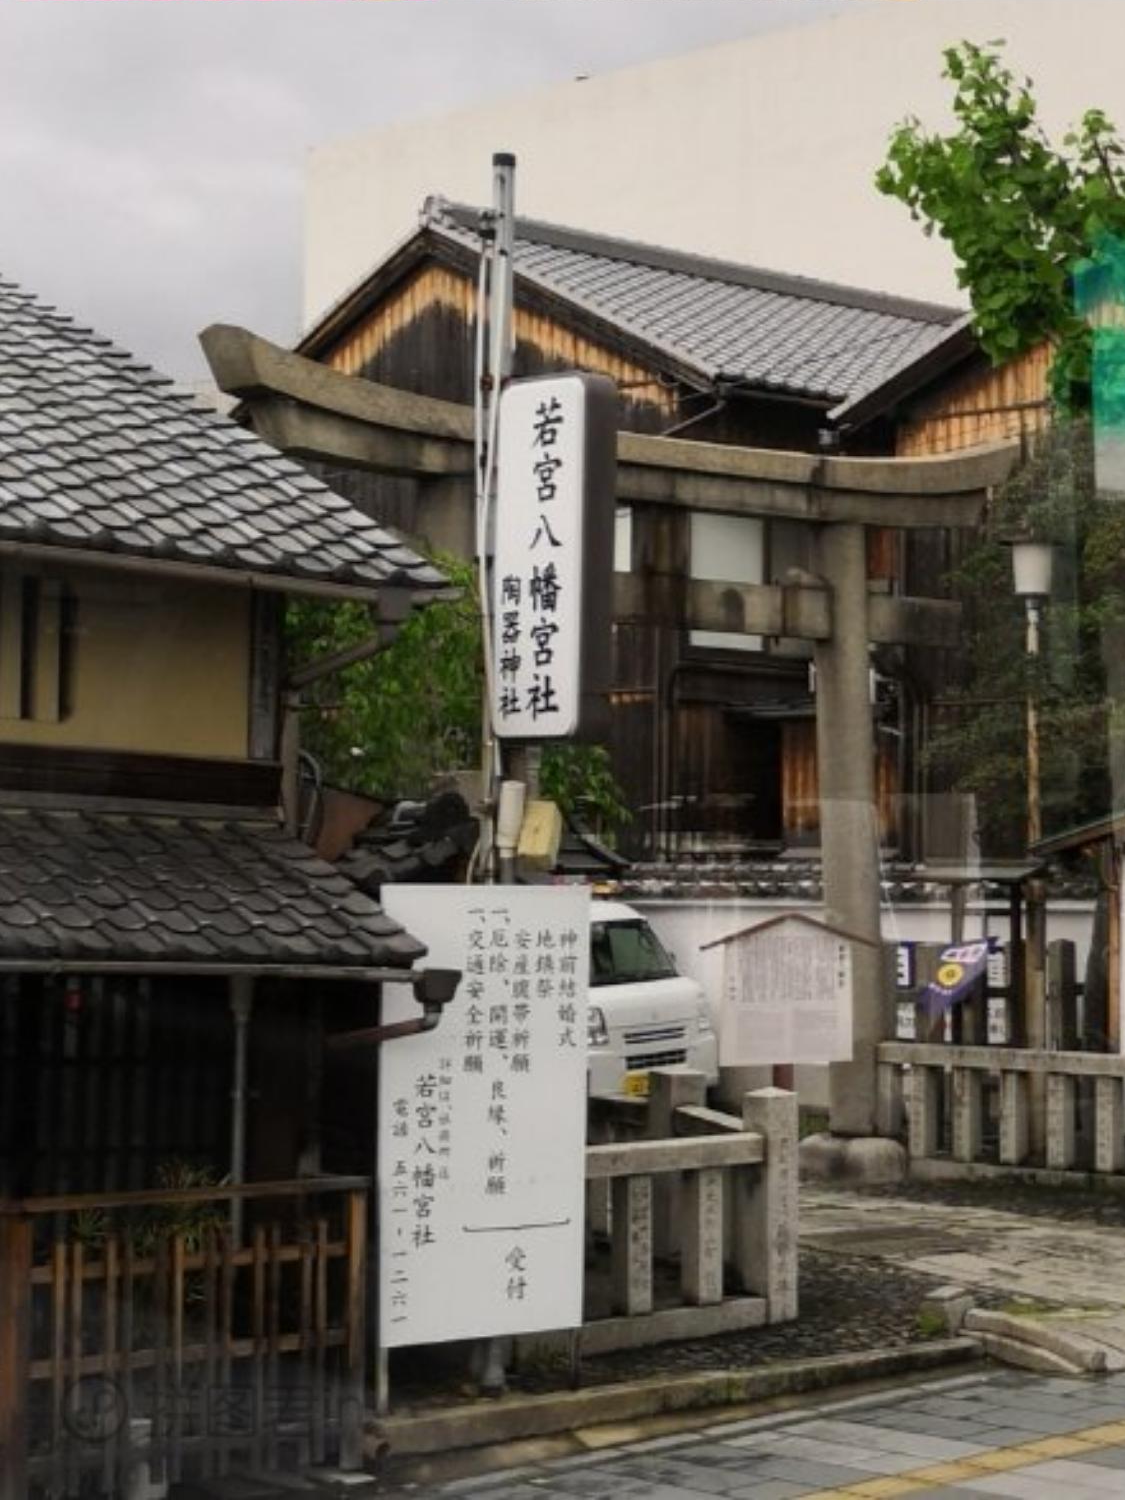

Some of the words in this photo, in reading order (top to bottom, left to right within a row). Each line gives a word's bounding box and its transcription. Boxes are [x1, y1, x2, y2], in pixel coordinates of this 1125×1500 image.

[526, 397, 564, 721] 若宮八幡宮社
[411, 1073, 437, 1249] 若宮八幡宮社
[505, 1245, 528, 1300] 受付
